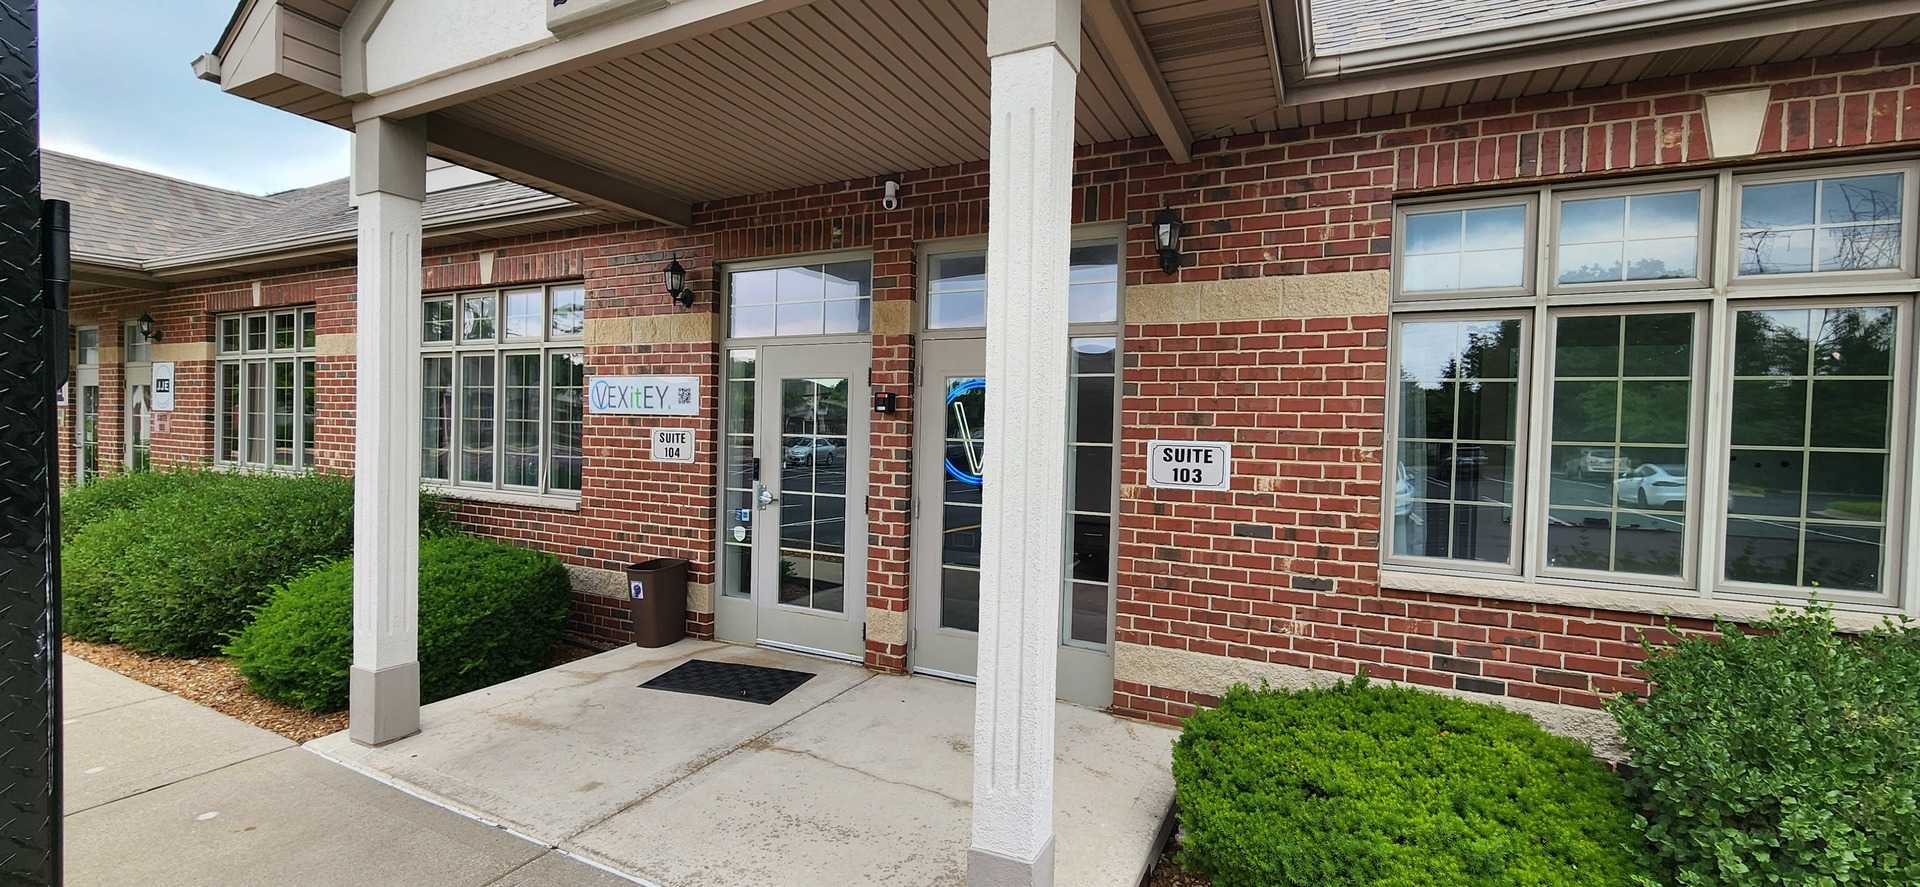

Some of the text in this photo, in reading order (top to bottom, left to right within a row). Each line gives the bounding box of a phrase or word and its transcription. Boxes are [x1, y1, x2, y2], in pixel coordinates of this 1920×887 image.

[659, 433, 686, 443] SUITE
[664, 447, 680, 458] 104
[1163, 448, 1213, 463] SUITE
[1172, 468, 1202, 483] 103
